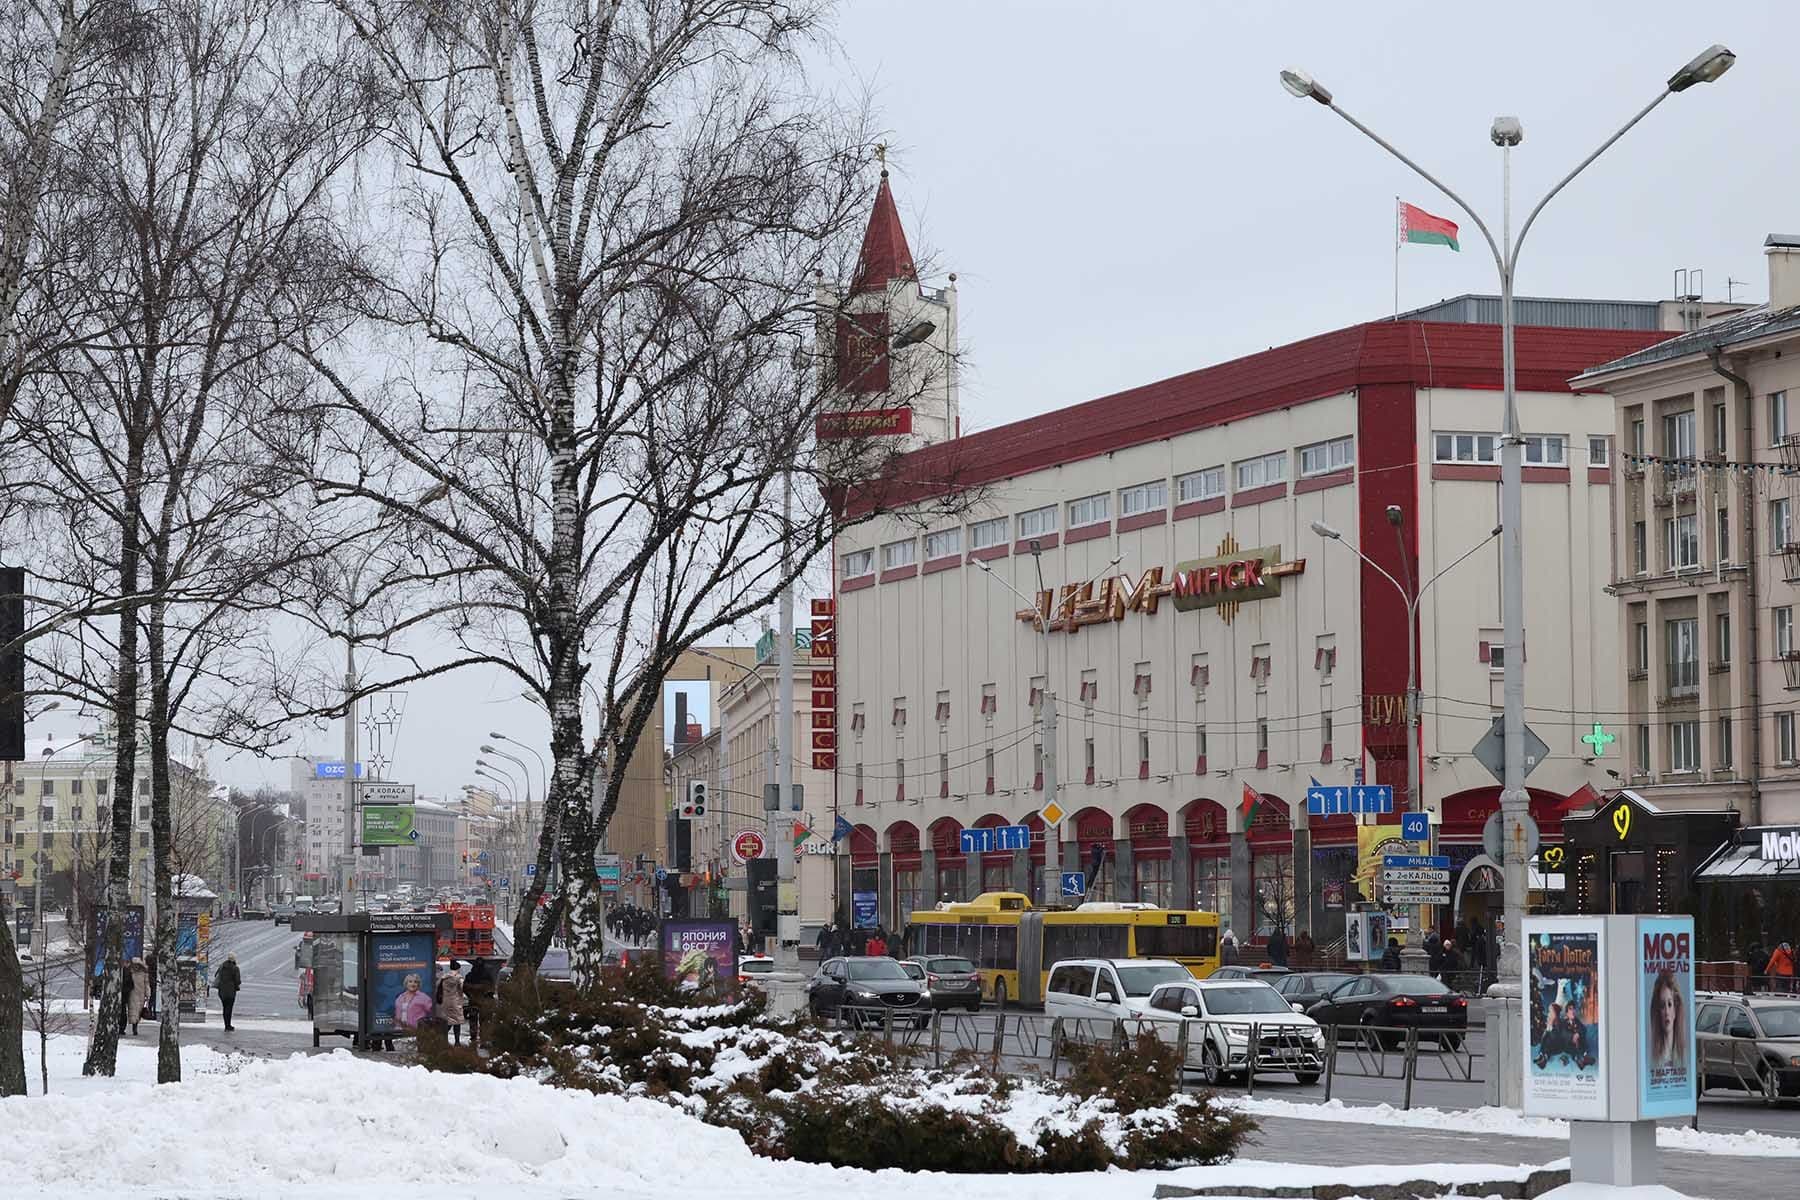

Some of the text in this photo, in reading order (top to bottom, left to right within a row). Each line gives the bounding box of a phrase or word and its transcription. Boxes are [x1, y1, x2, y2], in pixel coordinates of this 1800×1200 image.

[823, 414, 900, 432] ВЕРМАГ
[1033, 558, 1265, 633] ЦУМ МІНСК
[815, 602, 832, 767] ЦУМ МІНСК
[1370, 695, 1408, 726] ЦУМ
[1408, 822, 1423, 832] 40
[1408, 872, 1443, 880] КАЛЬЦО
[682, 931, 726, 941] ЯПОНИЯ
[682, 942, 709, 952] ФЕСТ
[1563, 944, 1592, 966] Поттер
[1643, 933, 1690, 960] МОЯ
[1644, 961, 1690, 974] МИШЕЛЬ
